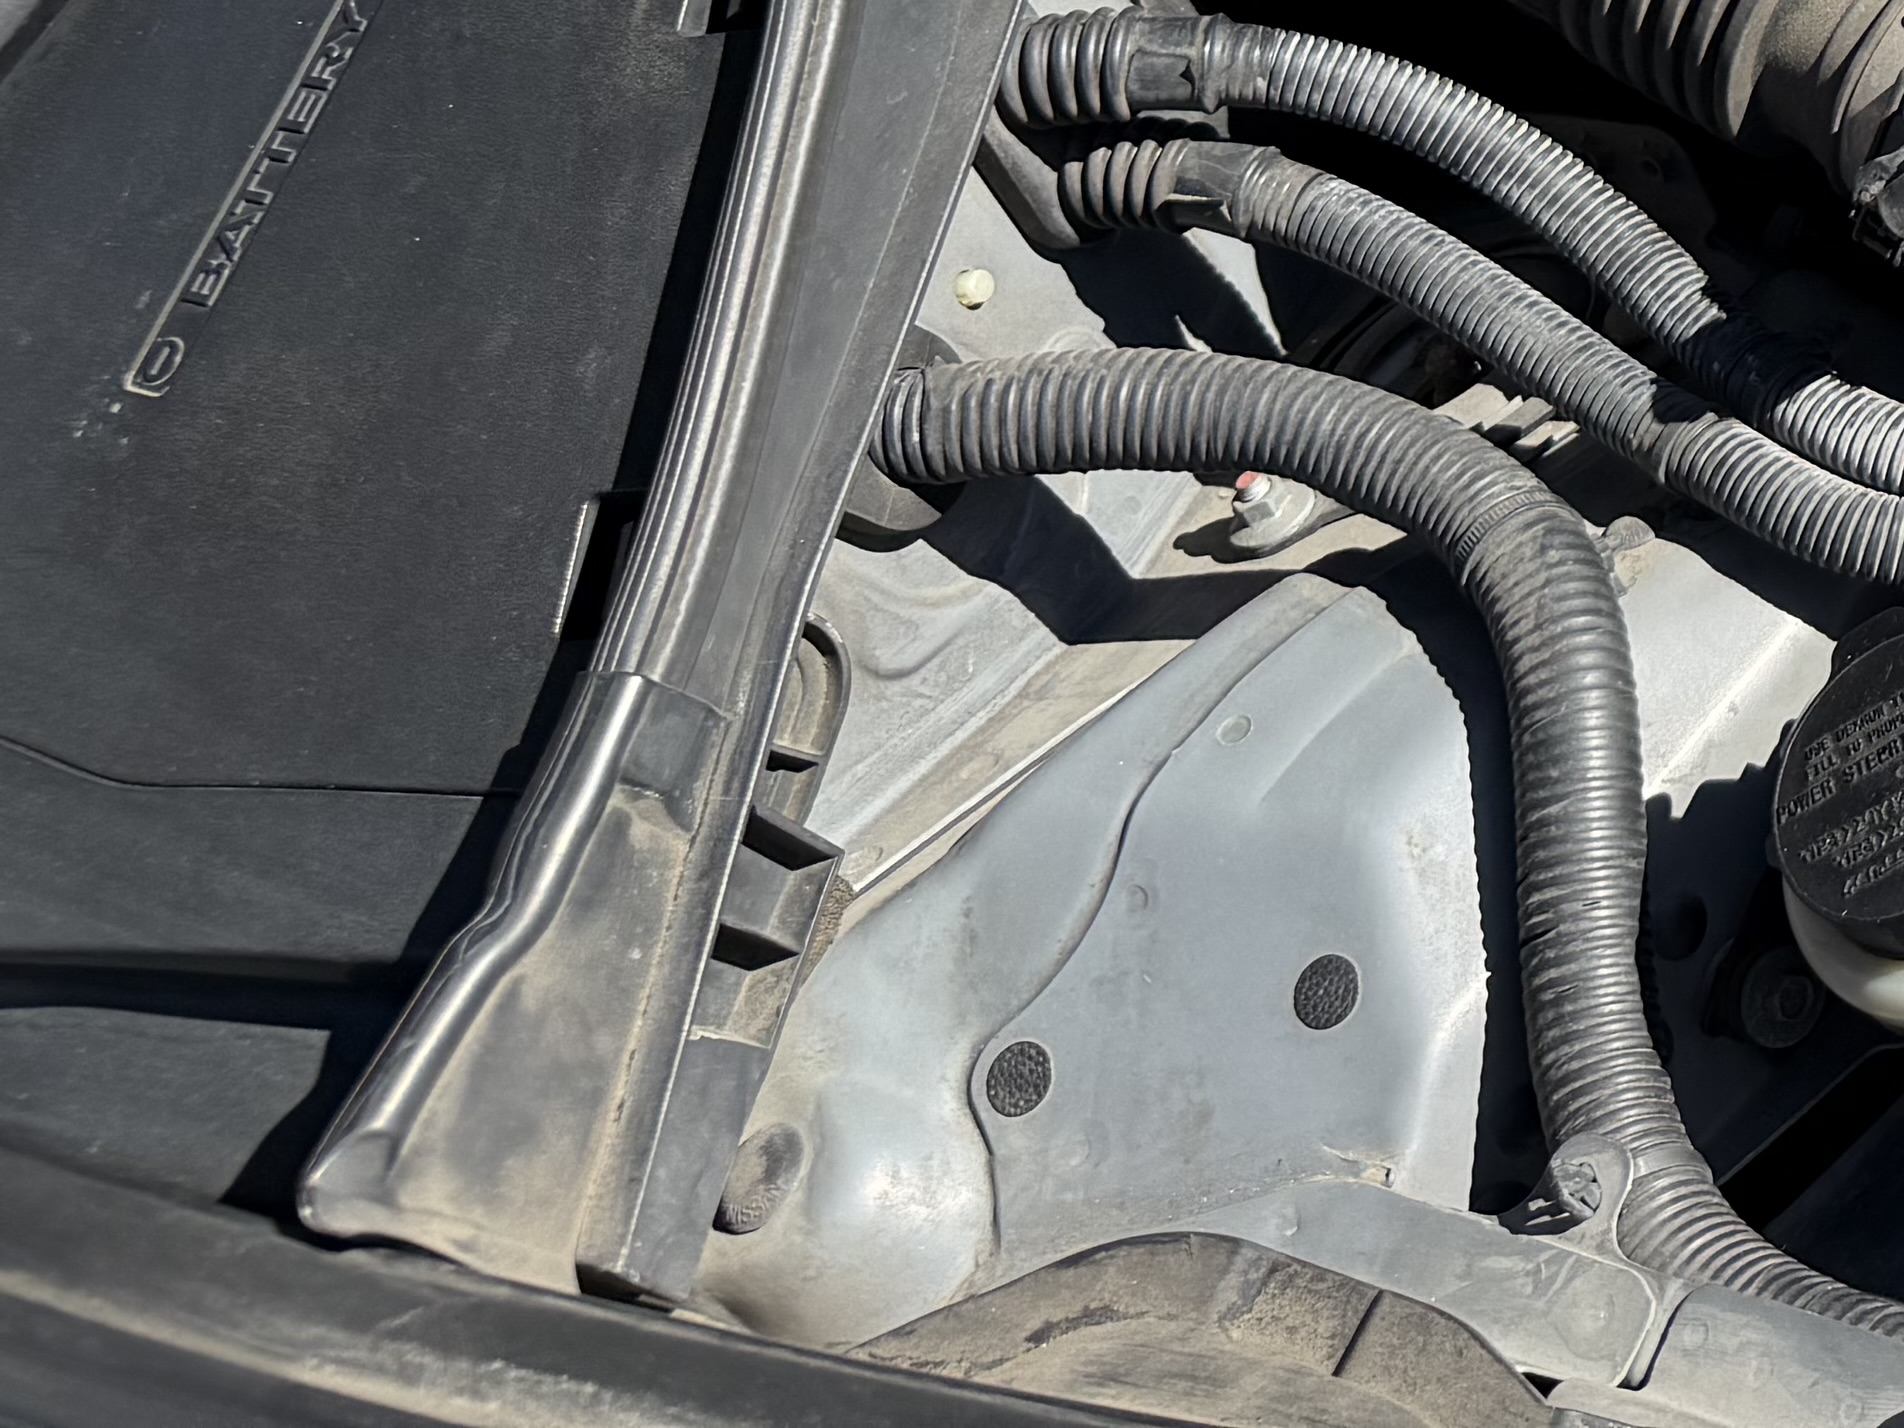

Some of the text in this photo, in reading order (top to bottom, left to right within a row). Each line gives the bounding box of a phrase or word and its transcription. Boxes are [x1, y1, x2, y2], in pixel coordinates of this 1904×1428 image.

[182, 0, 370, 307] BATTERY
[1800, 734, 1834, 762] USE
[1832, 701, 1890, 744] DEXRON
[1801, 749, 1841, 781] FILL
[1841, 734, 1866, 757] TO
[1771, 774, 1838, 825] POWER
